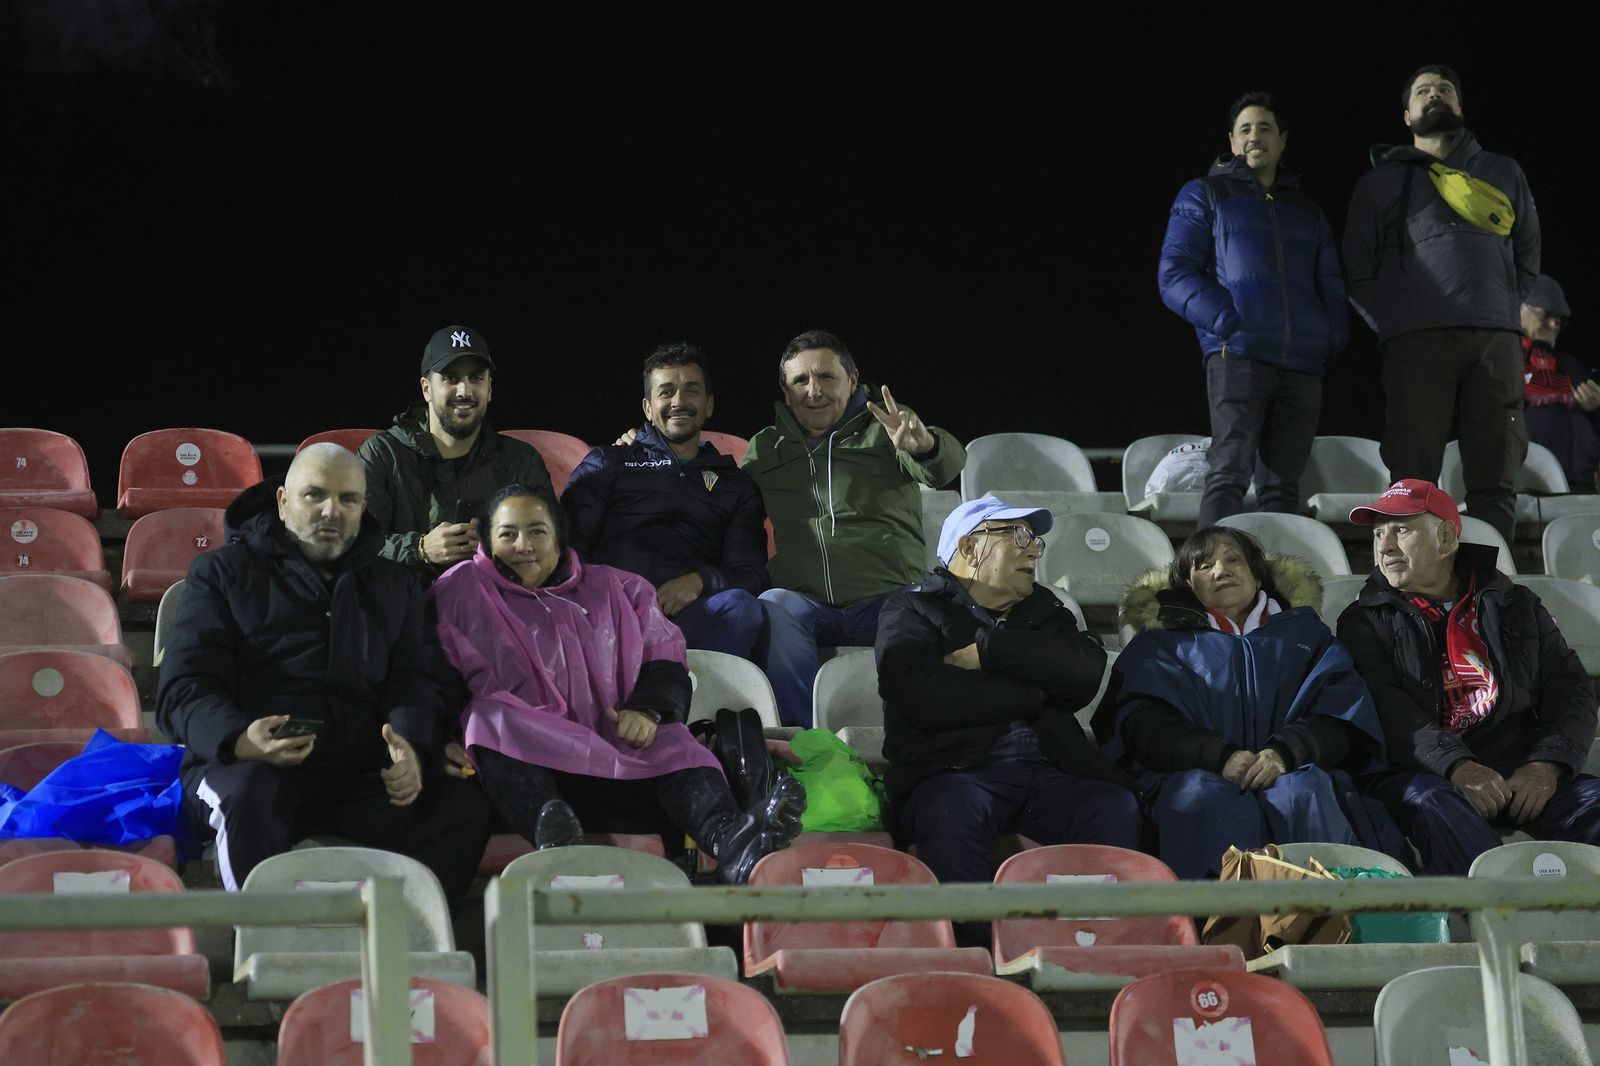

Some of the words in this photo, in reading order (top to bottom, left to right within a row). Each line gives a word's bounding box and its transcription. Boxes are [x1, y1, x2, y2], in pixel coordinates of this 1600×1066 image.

[451, 331, 471, 348] NY
[625, 460, 671, 468] GIVOVA
[196, 537, 207, 547] 72
[1199, 991, 1218, 1008] 66
